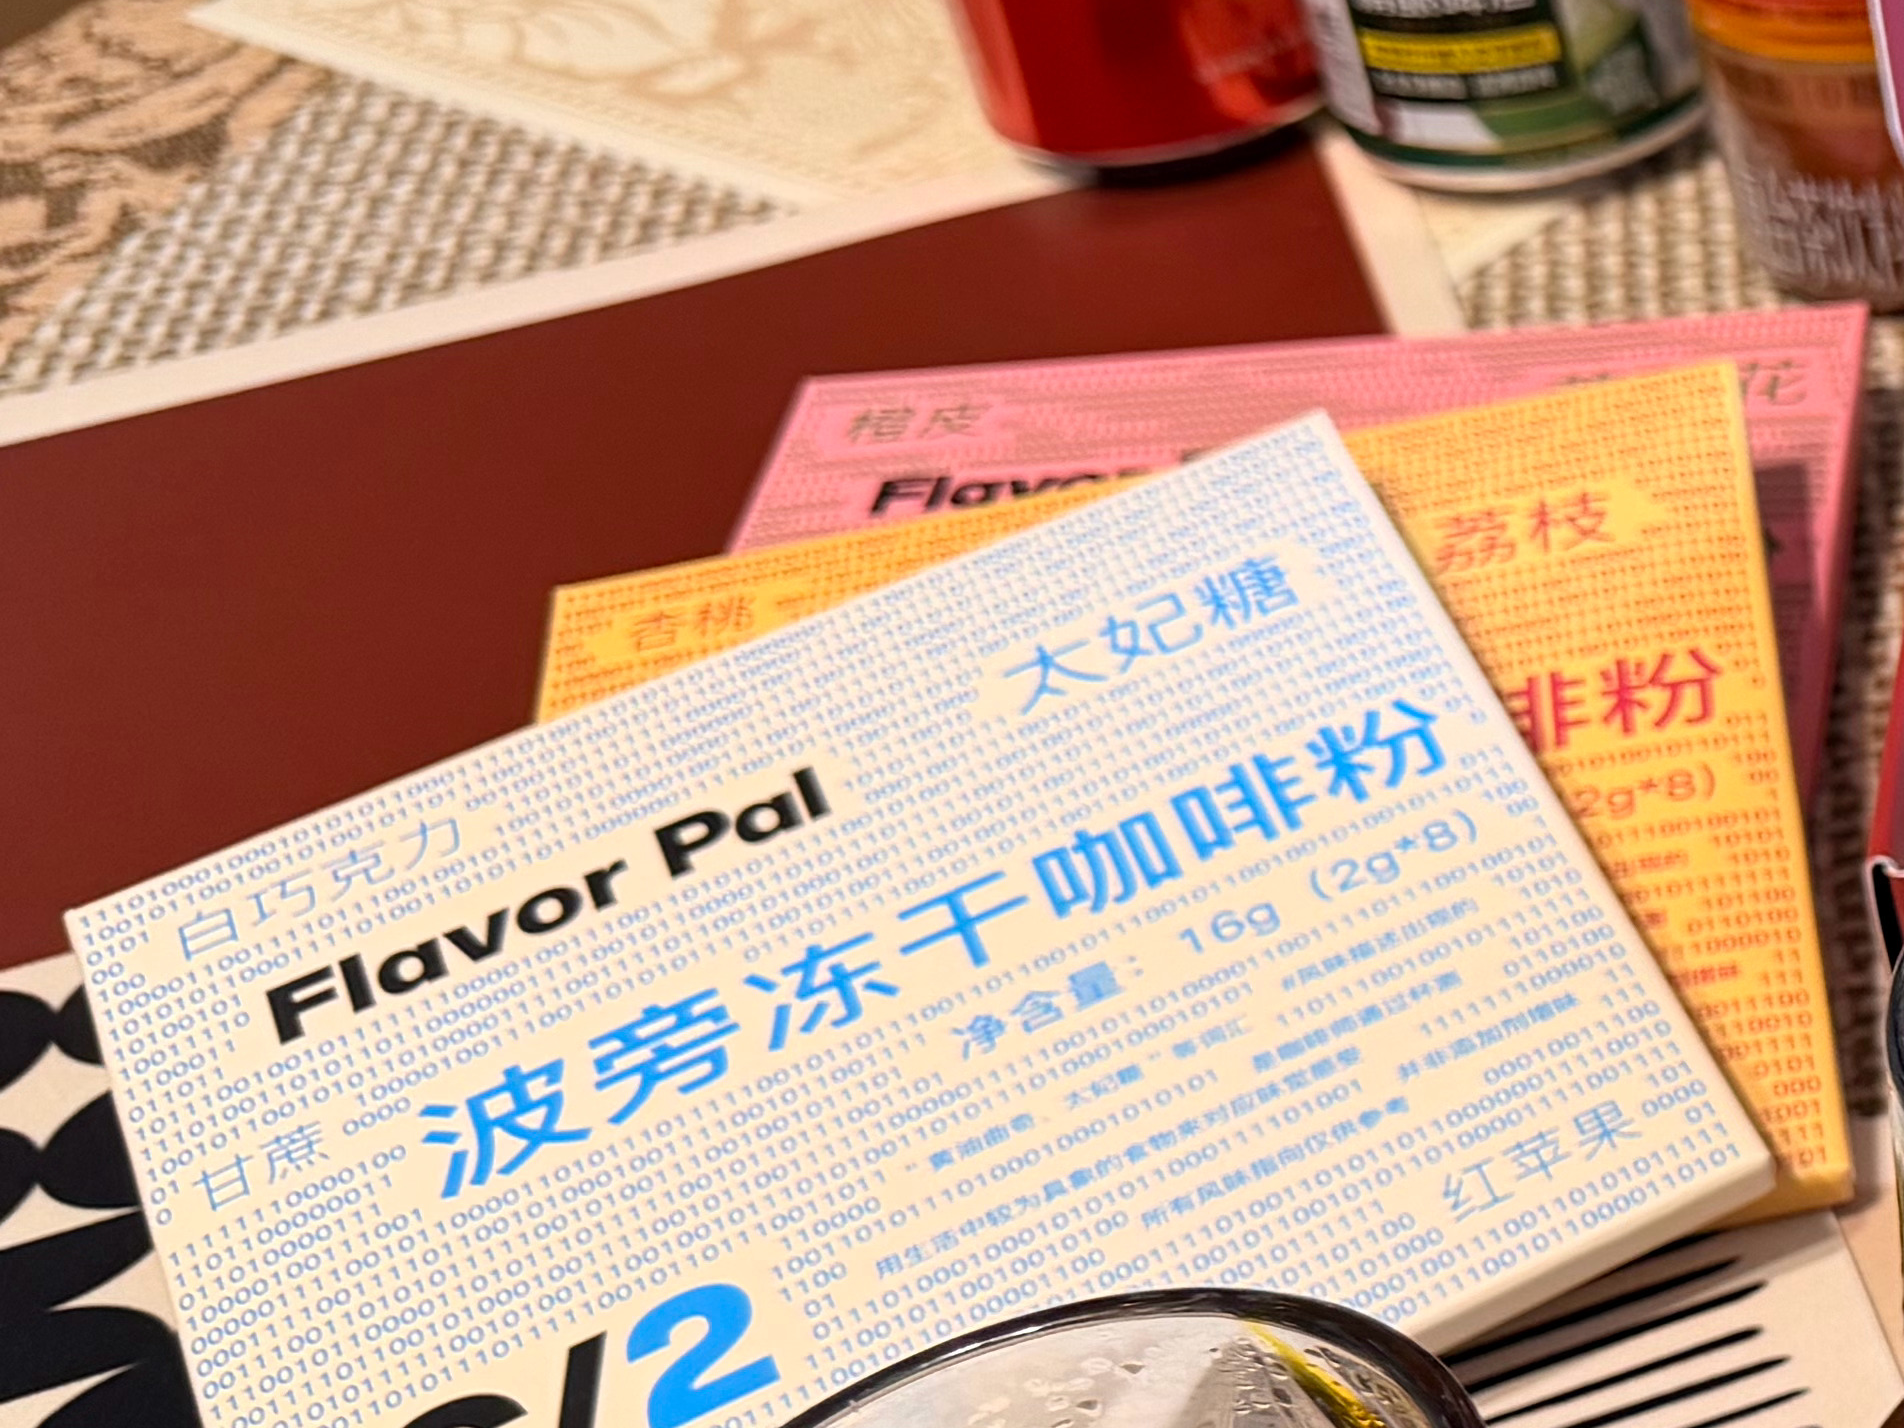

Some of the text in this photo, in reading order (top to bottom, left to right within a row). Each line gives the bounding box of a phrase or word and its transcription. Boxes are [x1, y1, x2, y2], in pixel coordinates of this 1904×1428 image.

[1434, 492, 1615, 572] 荔枝
[1003, 556, 1302, 714] 太妃糖
[1460, 745, 1504, 769] 011
[1482, 778, 1528, 802] 100
[1506, 796, 1538, 817] 00
[176, 817, 466, 963] 白巧克力
[1520, 869, 1581, 899] 1010
[265, 766, 834, 1045] Flavor Pal
[1179, 901, 1282, 955] 16g
[87, 931, 149, 966] 0101
[419, 699, 1446, 1200] 波旁冻干咖啡粉
[91, 962, 125, 985] 00
[101, 973, 145, 1003] 100
[1607, 964, 1635, 983] 11
[1601, 982, 1646, 1007] 111
[1646, 1060, 1694, 1088] 101
[1641, 1080, 1708, 1118] 0000
[1685, 1101, 1717, 1125] 01
[342, 1097, 411, 1136] 0000
[192, 1120, 329, 1211] 甘蔗
[1442, 1099, 1642, 1223] 红苹果
[151, 1180, 180, 1204] 01
[781, 1262, 847, 1302] 1100
[804, 1294, 835, 1318] 01
